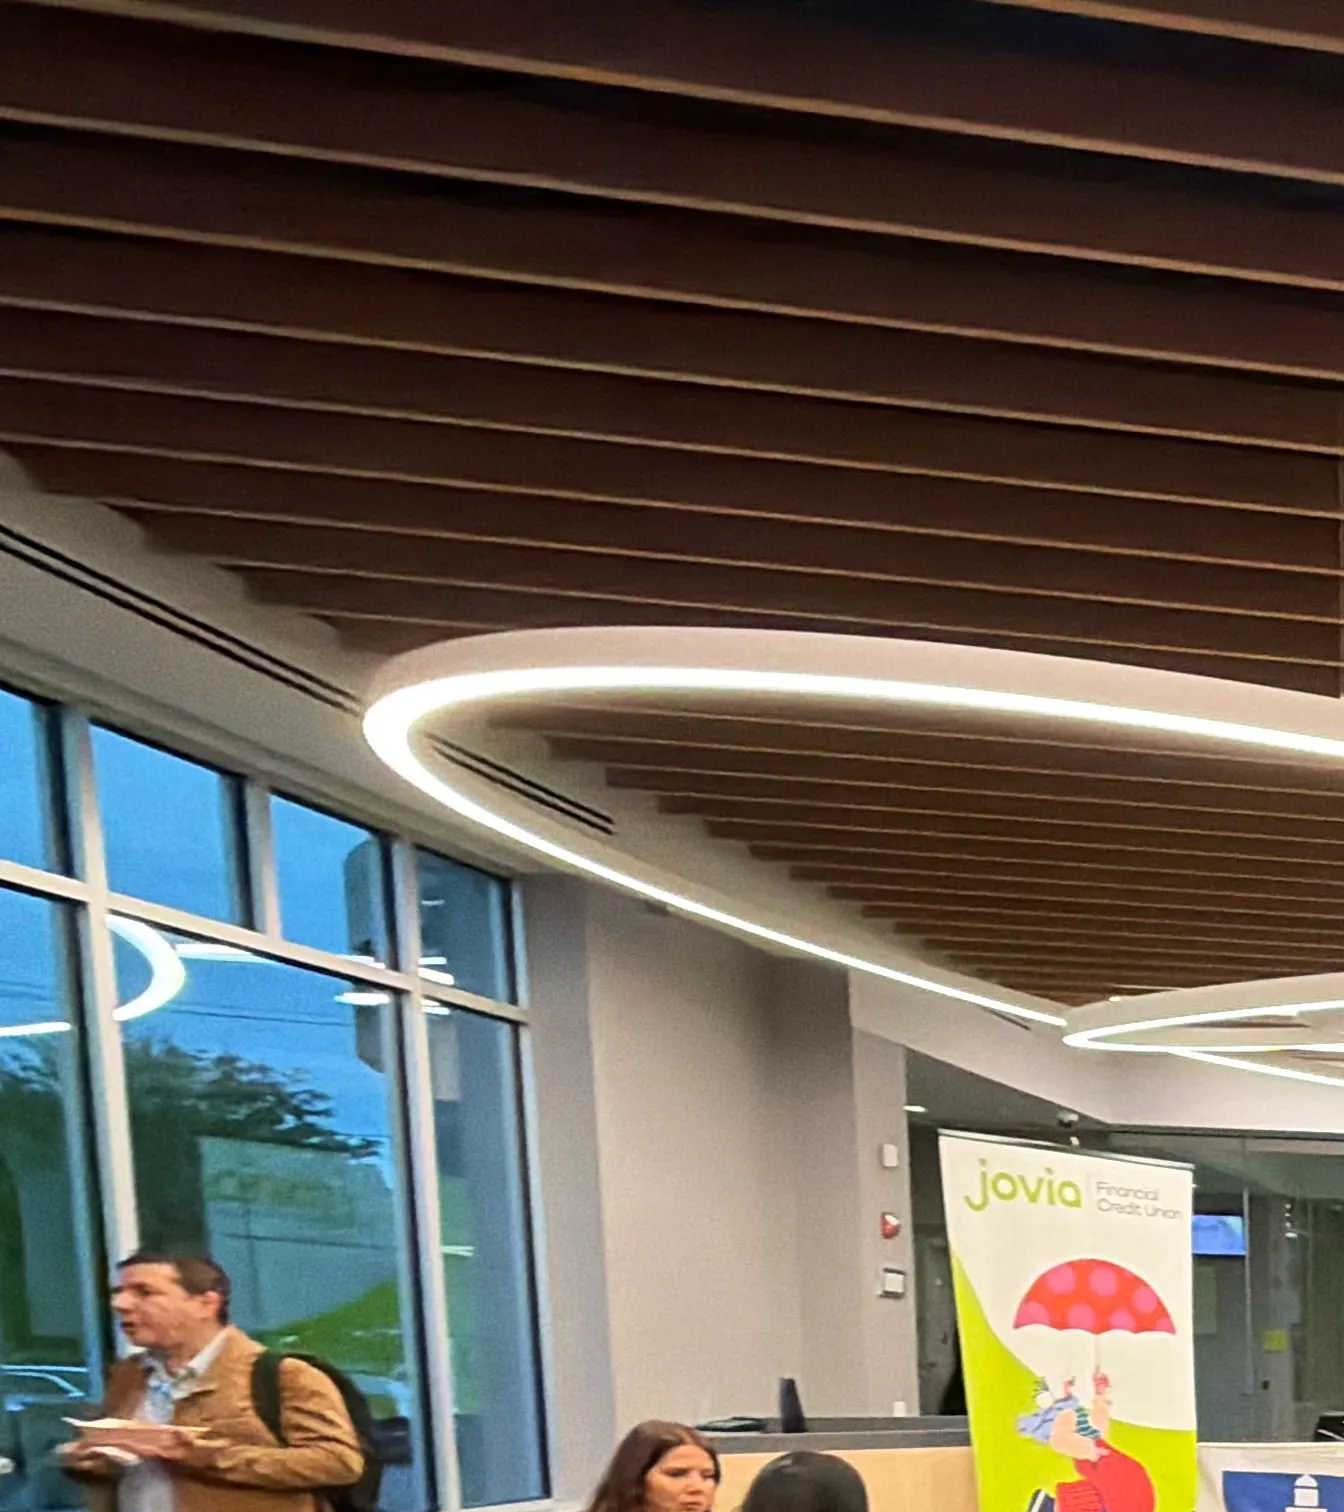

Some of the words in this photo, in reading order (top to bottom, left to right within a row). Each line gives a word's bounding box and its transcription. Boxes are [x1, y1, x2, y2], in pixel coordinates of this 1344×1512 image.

[964, 1158, 1082, 1211] jovia
[1096, 1181, 1159, 1200] Financial
[1097, 1198, 1141, 1216] Credit
[1146, 1206, 1182, 1219] Union
